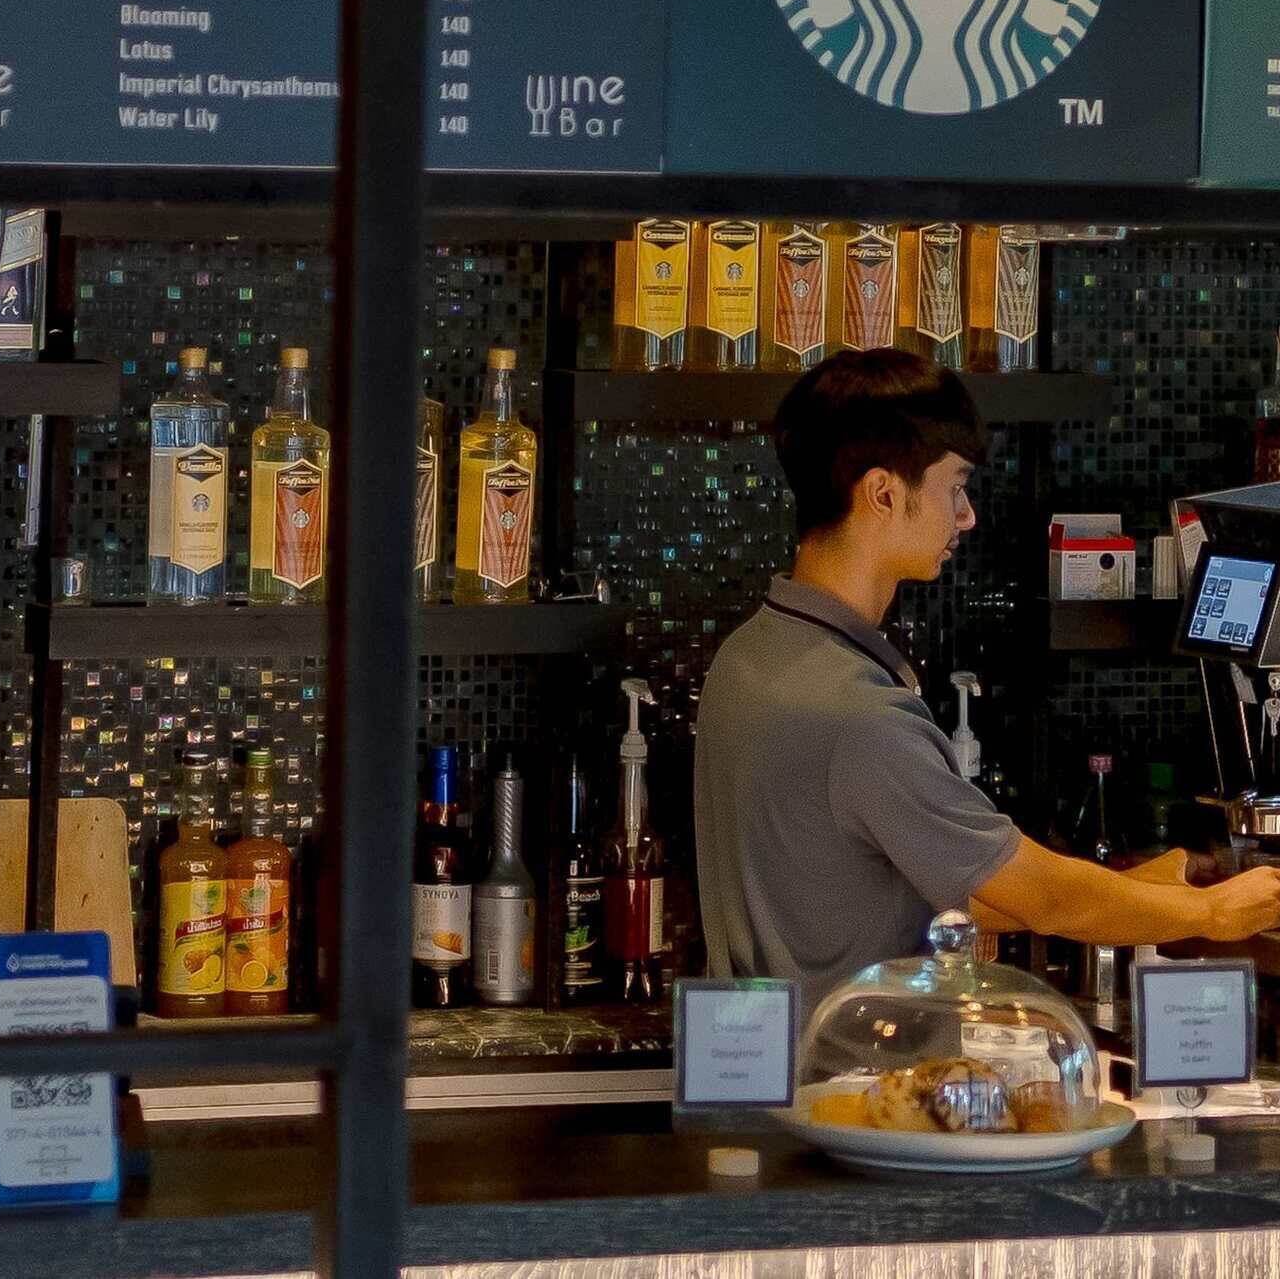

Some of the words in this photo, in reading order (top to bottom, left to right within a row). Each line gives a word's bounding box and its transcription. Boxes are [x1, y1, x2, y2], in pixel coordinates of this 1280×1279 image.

[120, 4, 211, 32] Blooming
[441, 16, 469, 34] 140
[119, 38, 174, 60] Lotus
[440, 49, 469, 67] 140
[119, 72, 203, 98] Imperial
[439, 82, 469, 100] 140
[118, 106, 179, 128] Water
[183, 108, 219, 132] Lily
[559, 107, 623, 137] Bar
[1059, 98, 1104, 126] TM
[439, 115, 468, 134] 140
[422, 887, 460, 900] SYNOVA
